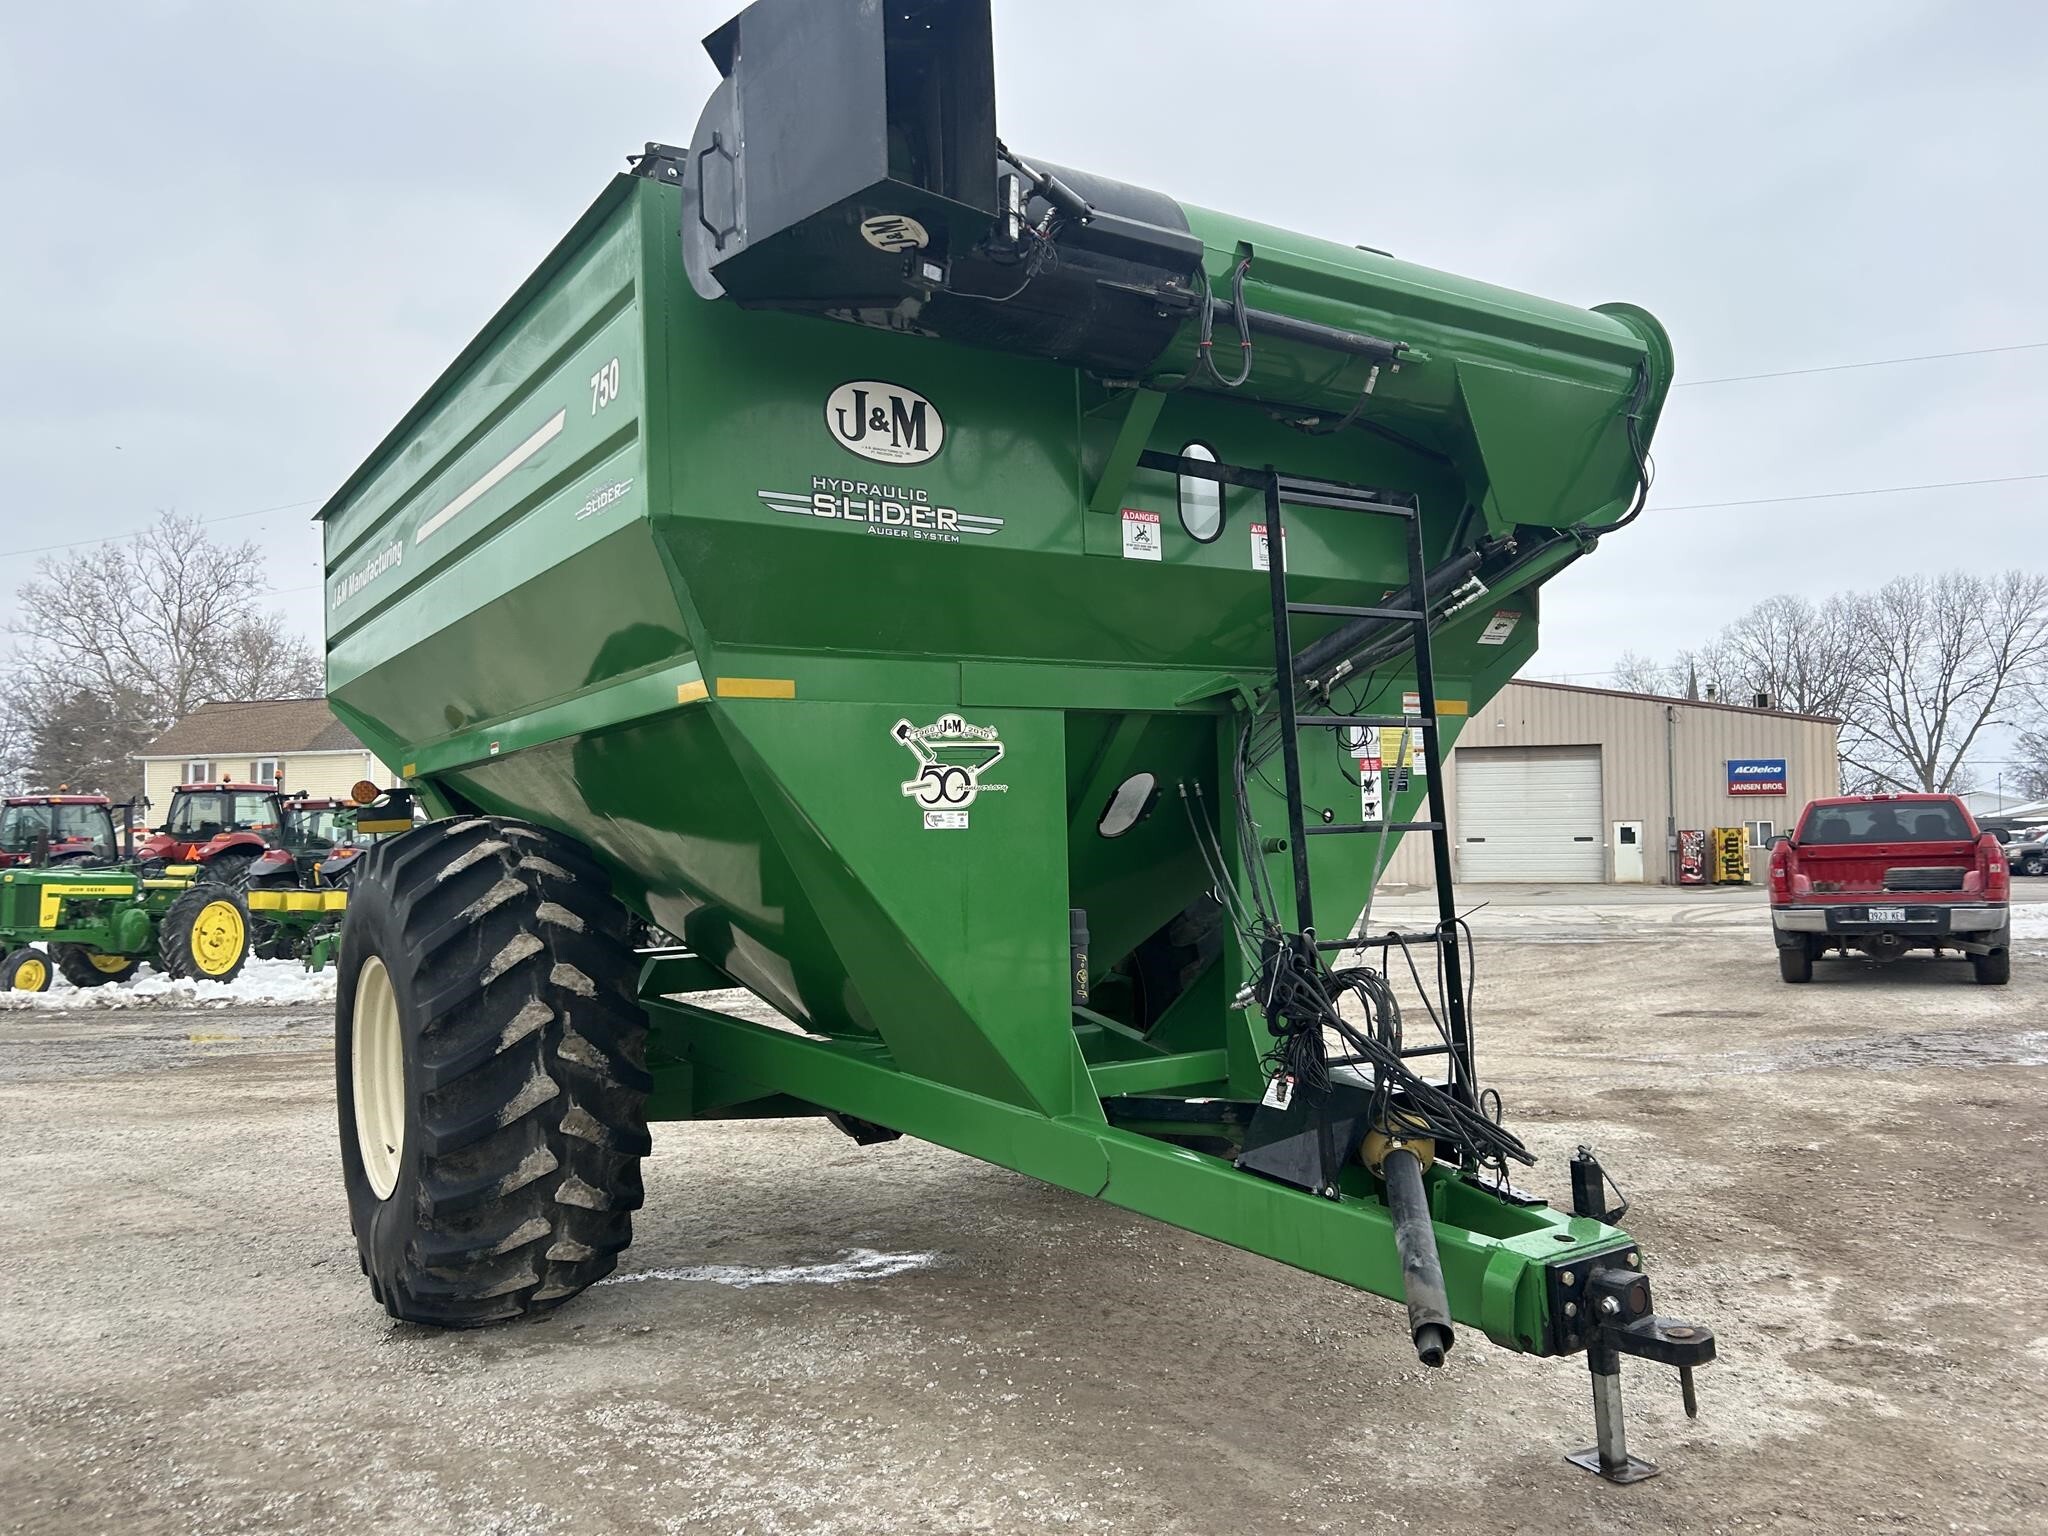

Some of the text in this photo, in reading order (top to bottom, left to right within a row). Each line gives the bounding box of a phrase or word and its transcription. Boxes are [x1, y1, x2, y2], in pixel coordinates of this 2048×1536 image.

[590, 357, 620, 417] 750
[835, 389, 930, 452] J&M
[585, 483, 621, 513] SLIDER
[812, 476, 928, 502] HYDRAULIC
[812, 493, 961, 532] SLIDER
[1130, 511, 1160, 523] DANGER
[348, 540, 403, 598] Manufacturing
[939, 719, 962, 733] J&M
[920, 765, 971, 804] 50
[1734, 766, 1782, 774] ACDelco
[1731, 783, 1761, 791] JANSEN
